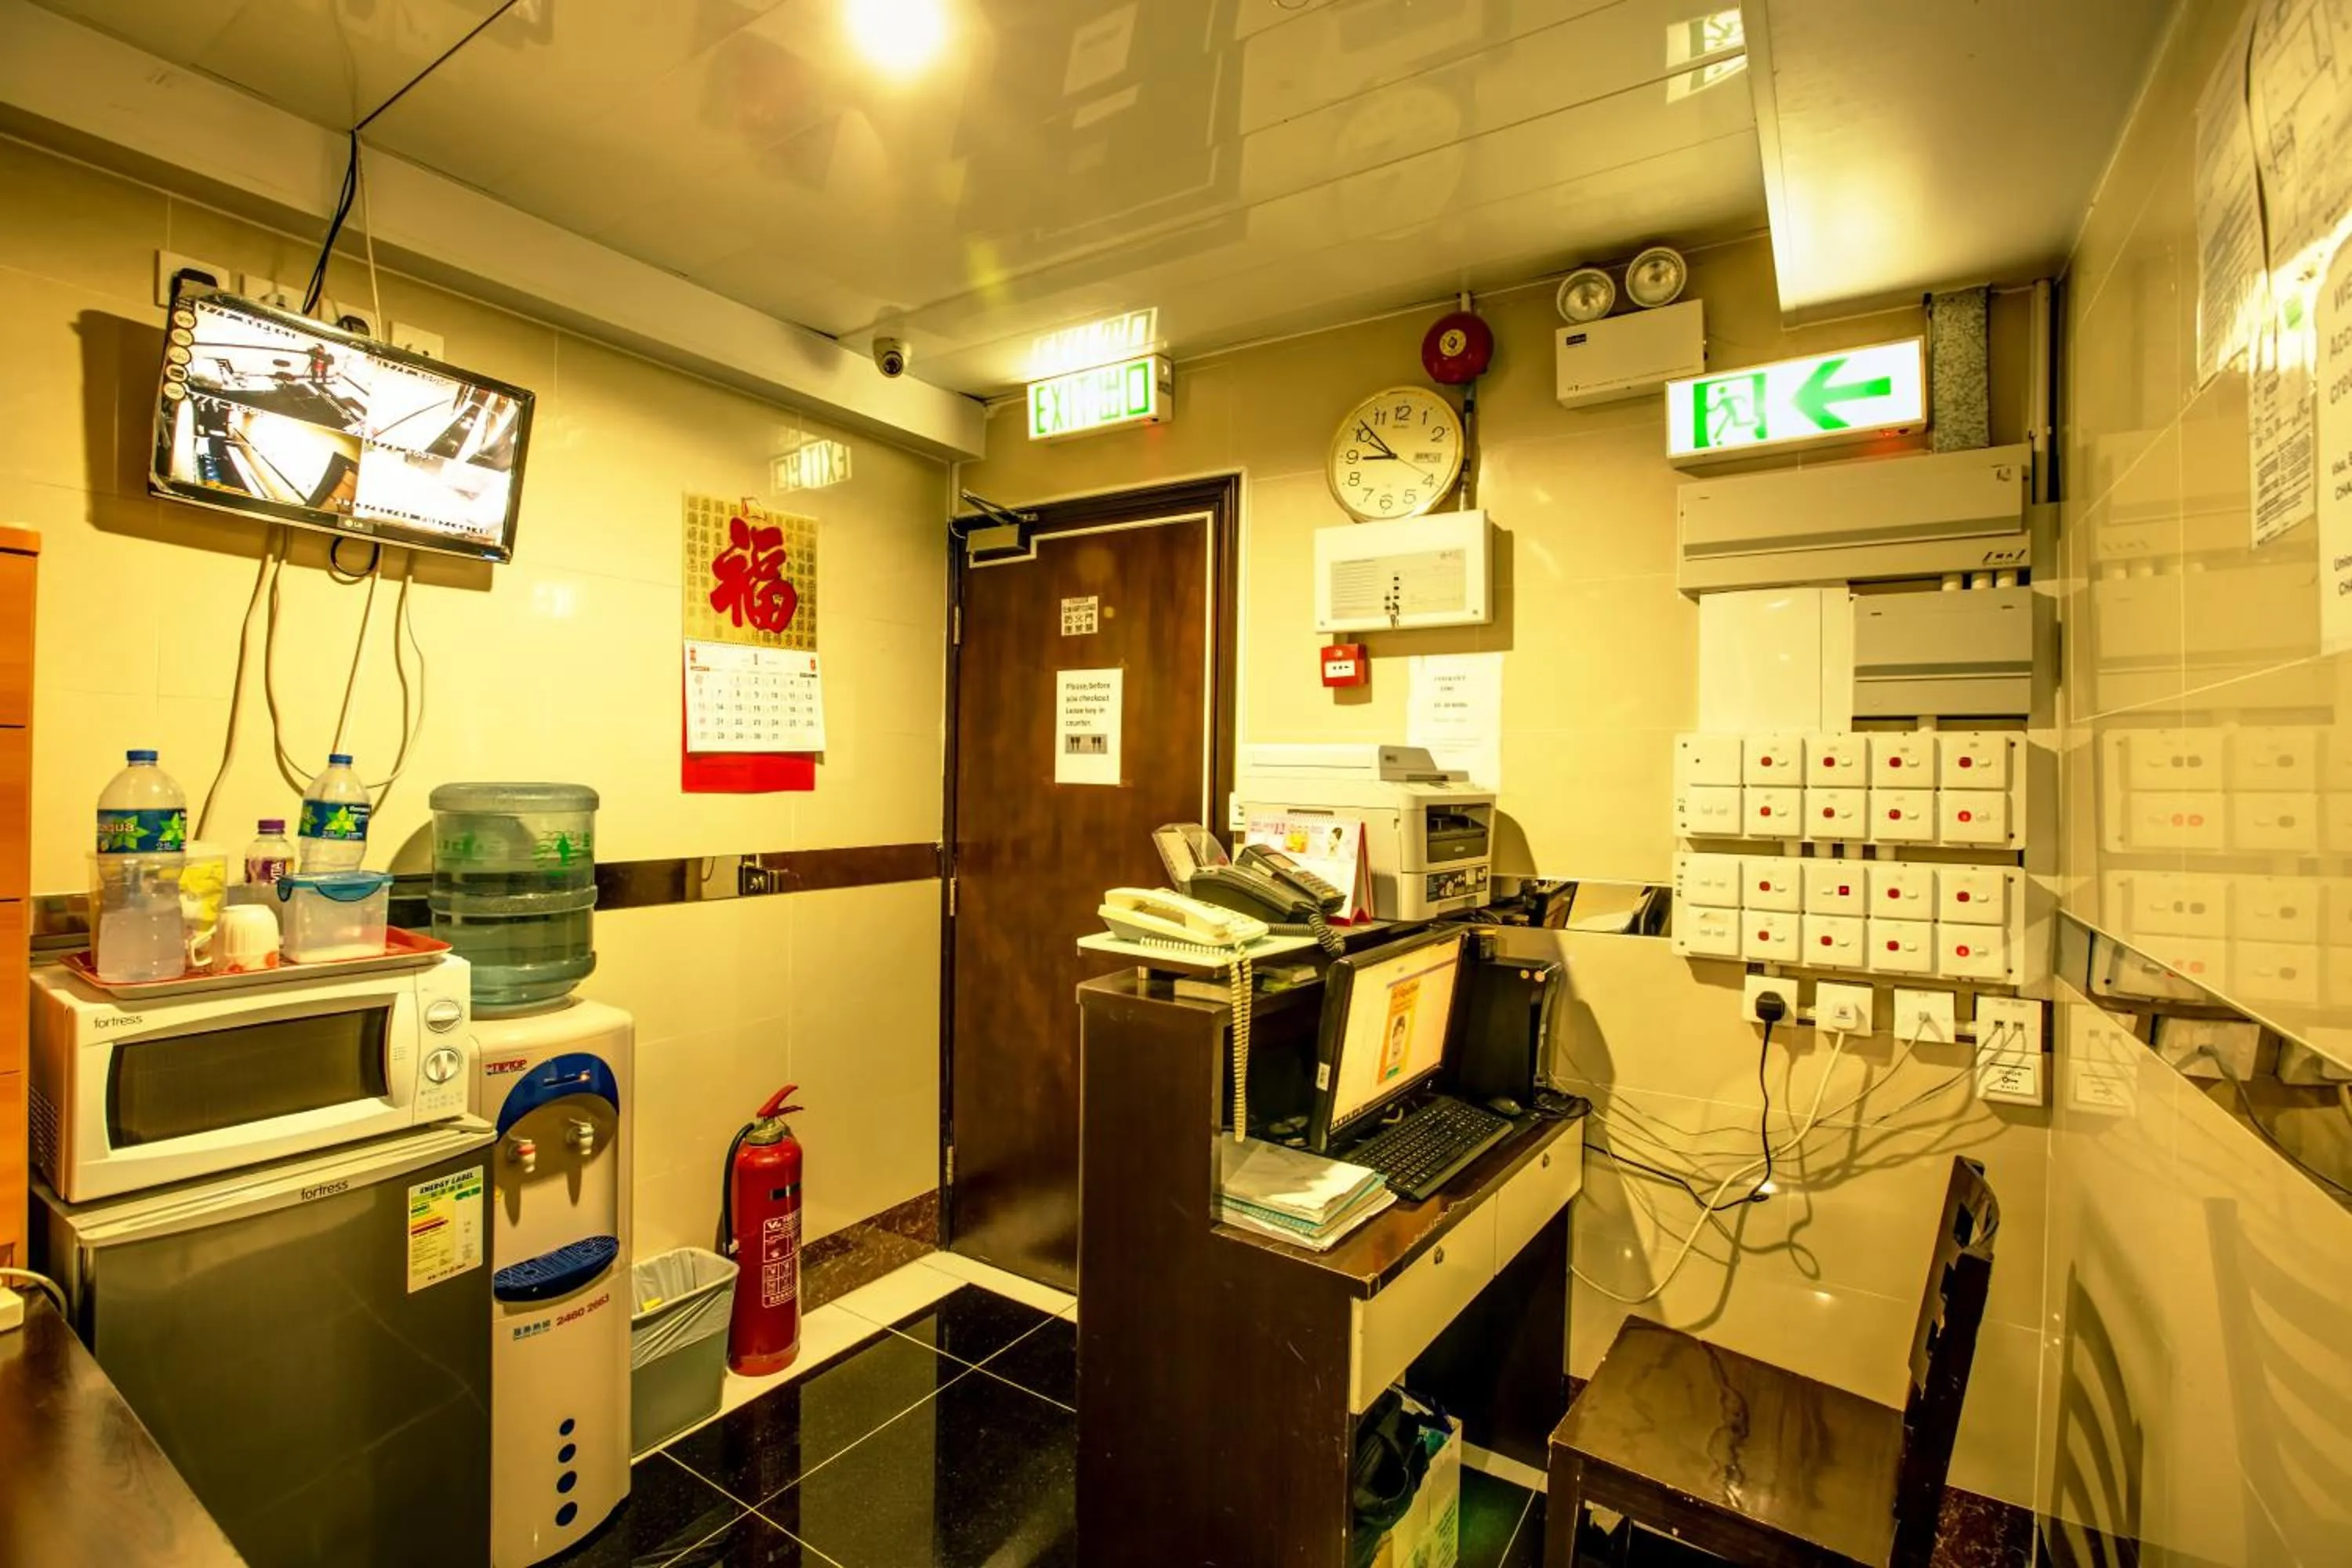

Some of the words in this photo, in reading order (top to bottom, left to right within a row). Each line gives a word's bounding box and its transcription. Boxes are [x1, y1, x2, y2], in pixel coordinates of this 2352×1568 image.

[1035, 376, 1090, 434] EXIT
[1374, 411, 1386, 425] 11
[1395, 405, 1411, 421] 12
[1422, 410, 1428, 425] 1
[1356, 428, 1372, 443] 10
[1431, 426, 1445, 443] 2
[1345, 450, 1359, 464] 9
[1348, 472, 1360, 487] 8
[1422, 474, 1435, 487] 4
[1363, 488, 1374, 503] 7
[1379, 494, 1393, 510] 6
[1403, 489, 1417, 504] 5
[710, 517, 797, 634] 福
[94, 1015, 143, 1029] fortress
[300, 1179, 349, 1200] fortress
[420, 1178, 449, 1194] ENERGY
[451, 1171, 473, 1185] LABEL
